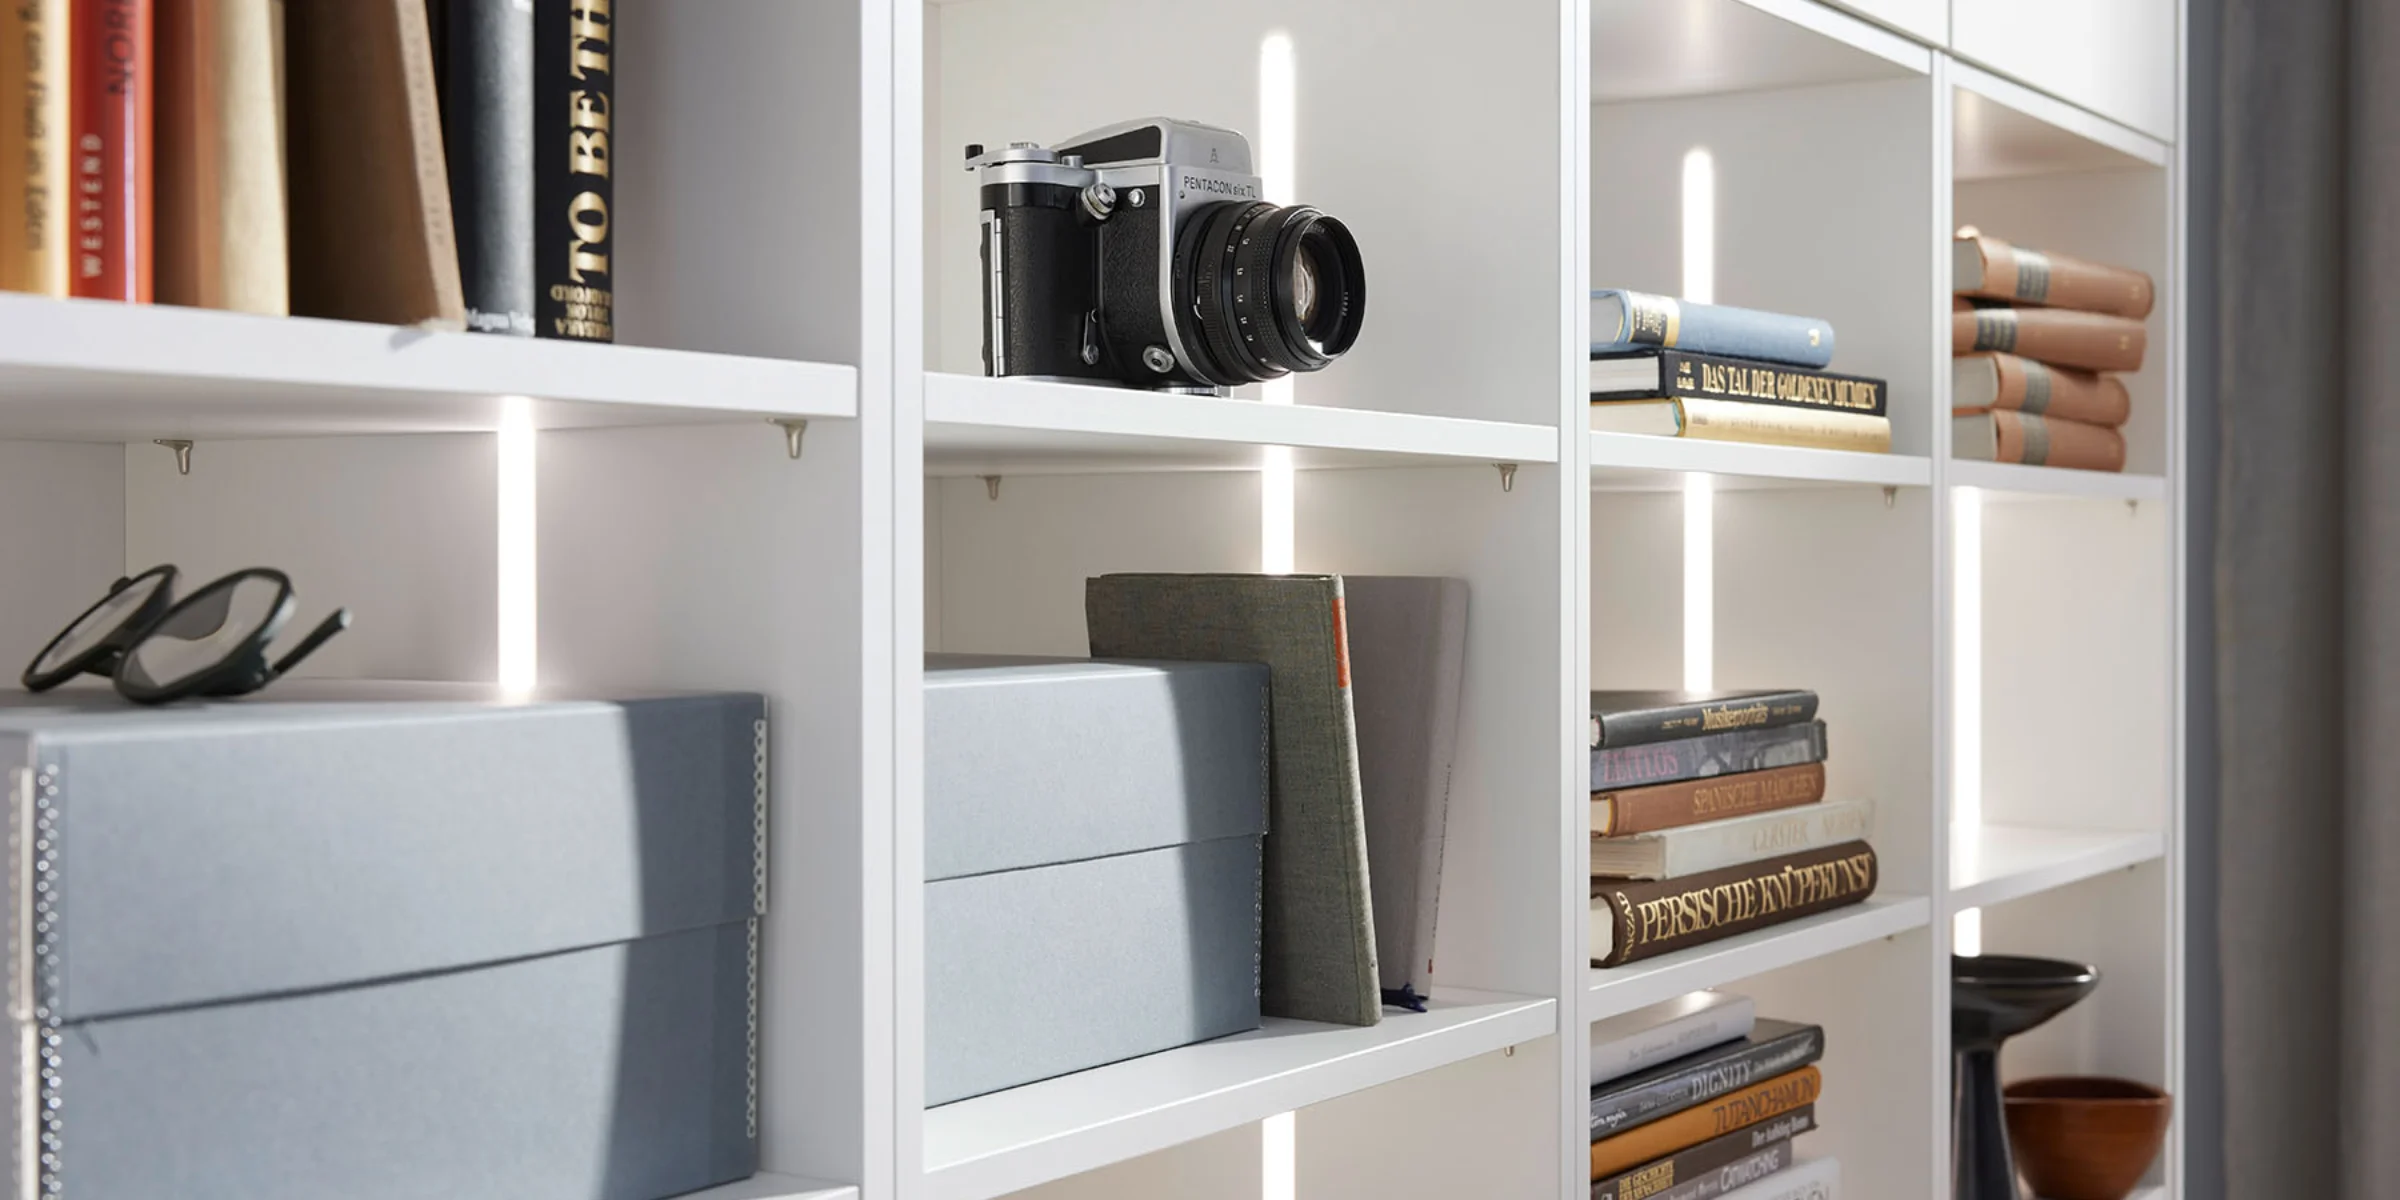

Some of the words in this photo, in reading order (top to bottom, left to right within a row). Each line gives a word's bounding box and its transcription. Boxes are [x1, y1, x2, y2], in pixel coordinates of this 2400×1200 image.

[104, 0, 136, 95] NOR
[569, 90, 610, 178] BE
[80, 133, 103, 278] WESTEND
[1184, 175, 1233, 195] PENTACON
[1233, 184, 1246, 197] six
[1246, 185, 1257, 198] TL
[567, 191, 609, 284] TO
[1702, 363, 1726, 394] DAS
[1727, 366, 1750, 396] TAL
[1751, 368, 1777, 399] DER
[1777, 372, 1833, 405] GOLDENEN
[1693, 782, 1757, 815] SPANISCHE
[1637, 877, 1758, 945] PERSISCHE
[1758, 852, 1873, 915] KNÜPFKUNST
[1691, 1060, 1750, 1101] DIGNITY
